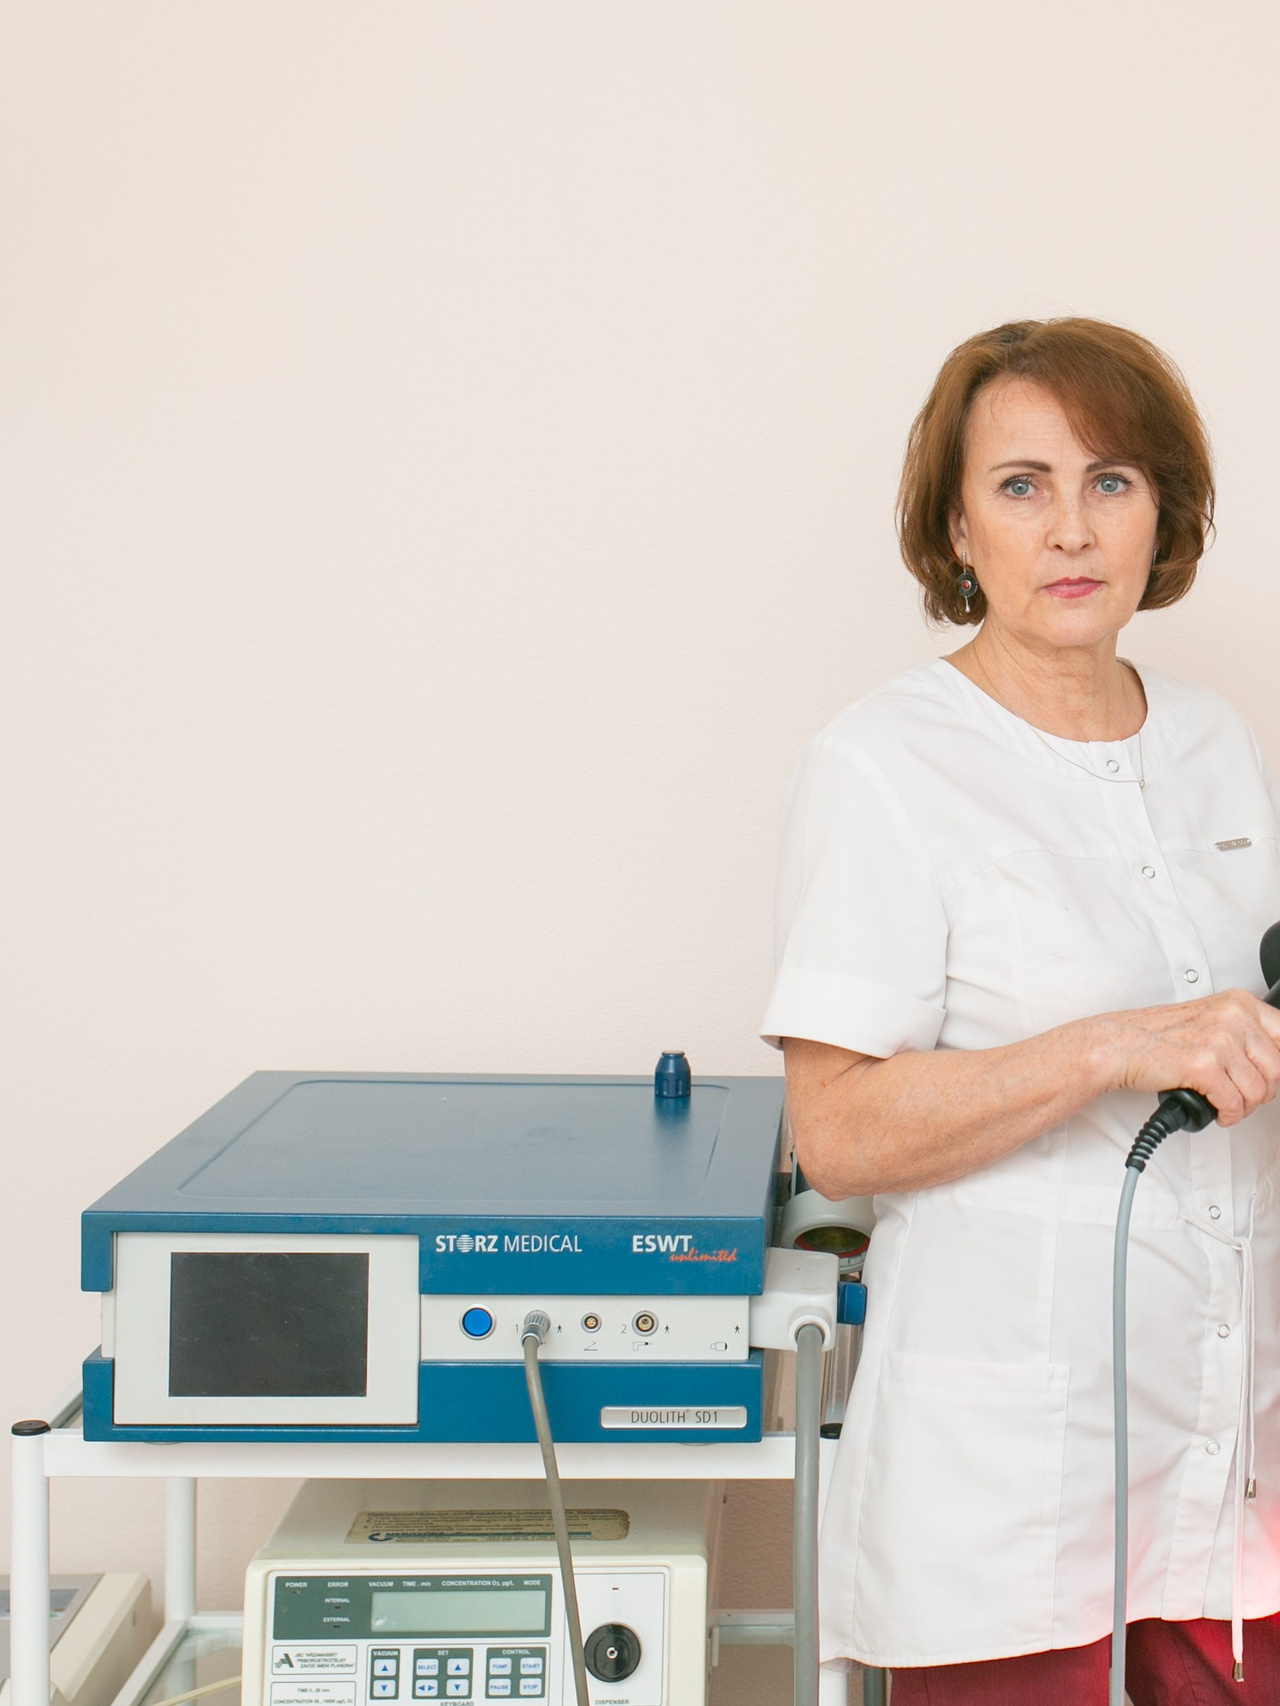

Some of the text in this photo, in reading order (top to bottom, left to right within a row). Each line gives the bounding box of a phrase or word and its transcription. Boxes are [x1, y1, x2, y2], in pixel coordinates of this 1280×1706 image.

[435, 1234, 582, 1253] STORZ MEDICAL
[633, 1235, 692, 1252] ESWT
[669, 1248, 737, 1262] unlimited
[621, 1324, 627, 1334] 2
[695, 1410, 718, 1423] SD1
